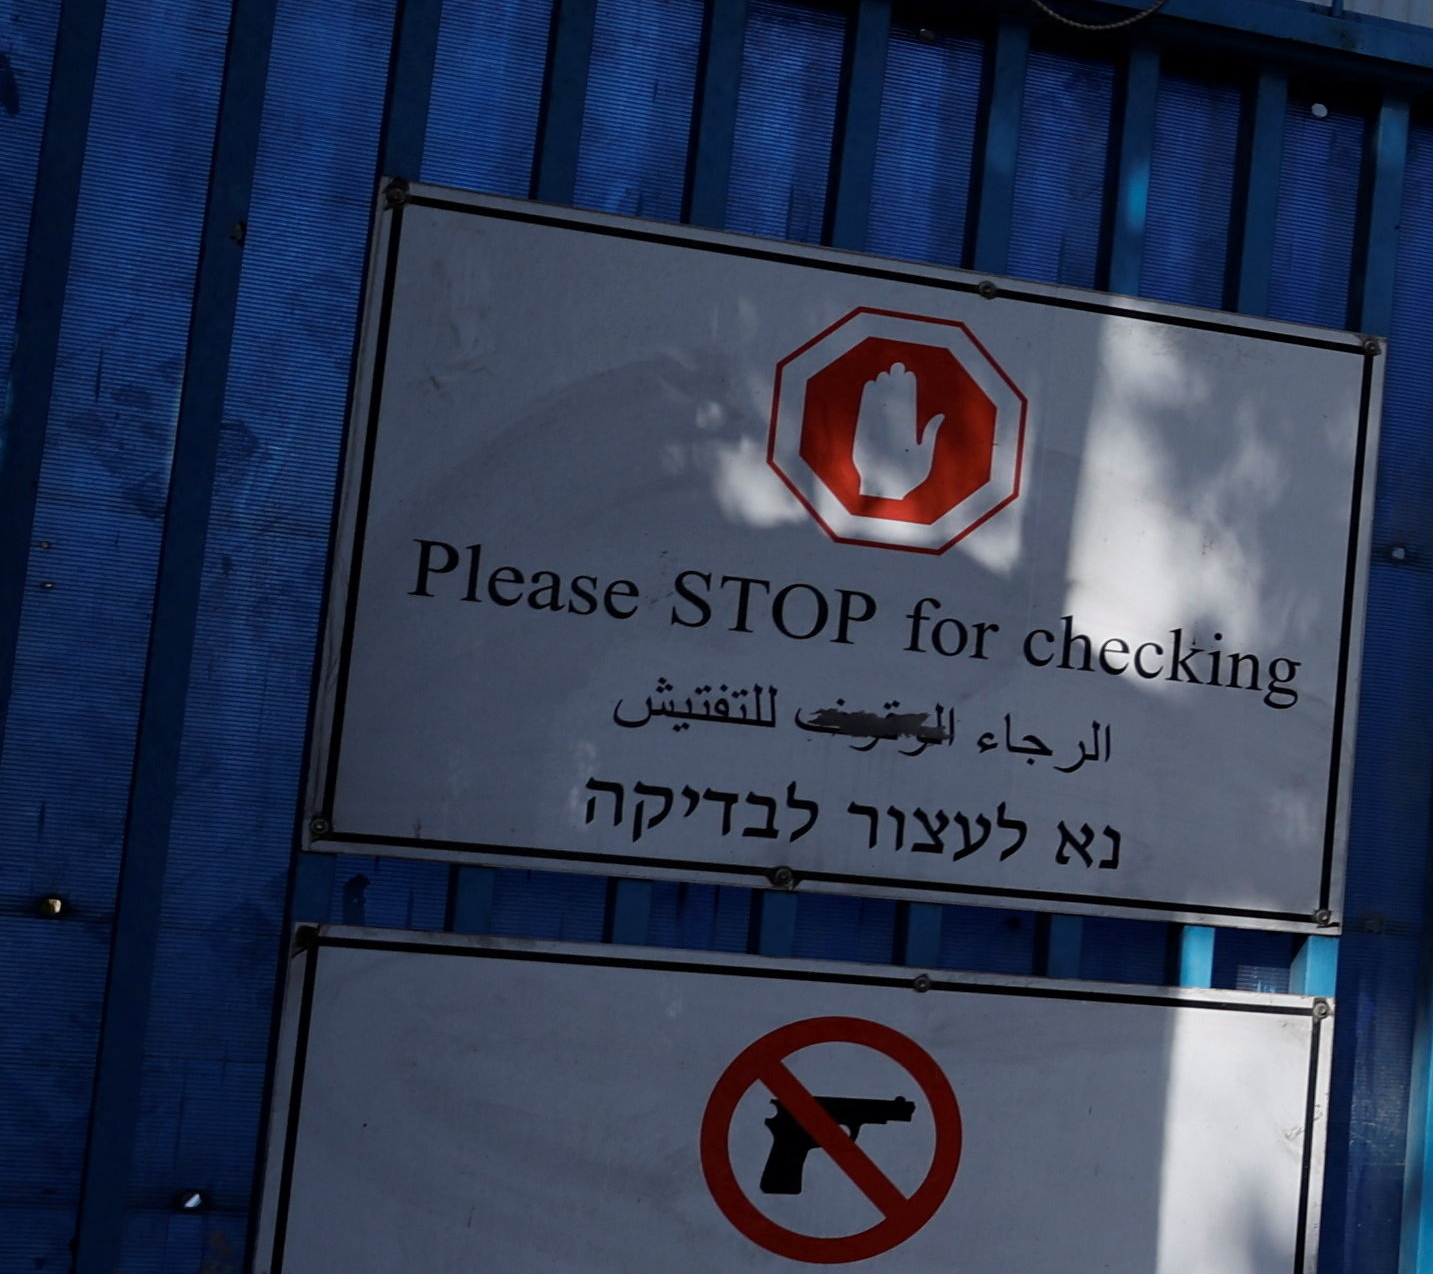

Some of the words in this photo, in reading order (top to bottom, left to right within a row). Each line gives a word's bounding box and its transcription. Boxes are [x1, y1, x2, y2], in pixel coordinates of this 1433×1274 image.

[407, 538, 640, 619] Please
[670, 570, 877, 645] STOP
[903, 597, 1000, 661] for
[1022, 615, 1302, 710] checking
[612, 676, 778, 732] للتفتيش
[976, 713, 1112, 774] الرجاء
[584, 776, 819, 844] לבדיקה
[846, 799, 1029, 862] לעצור
[1055, 820, 1122, 871] נא
